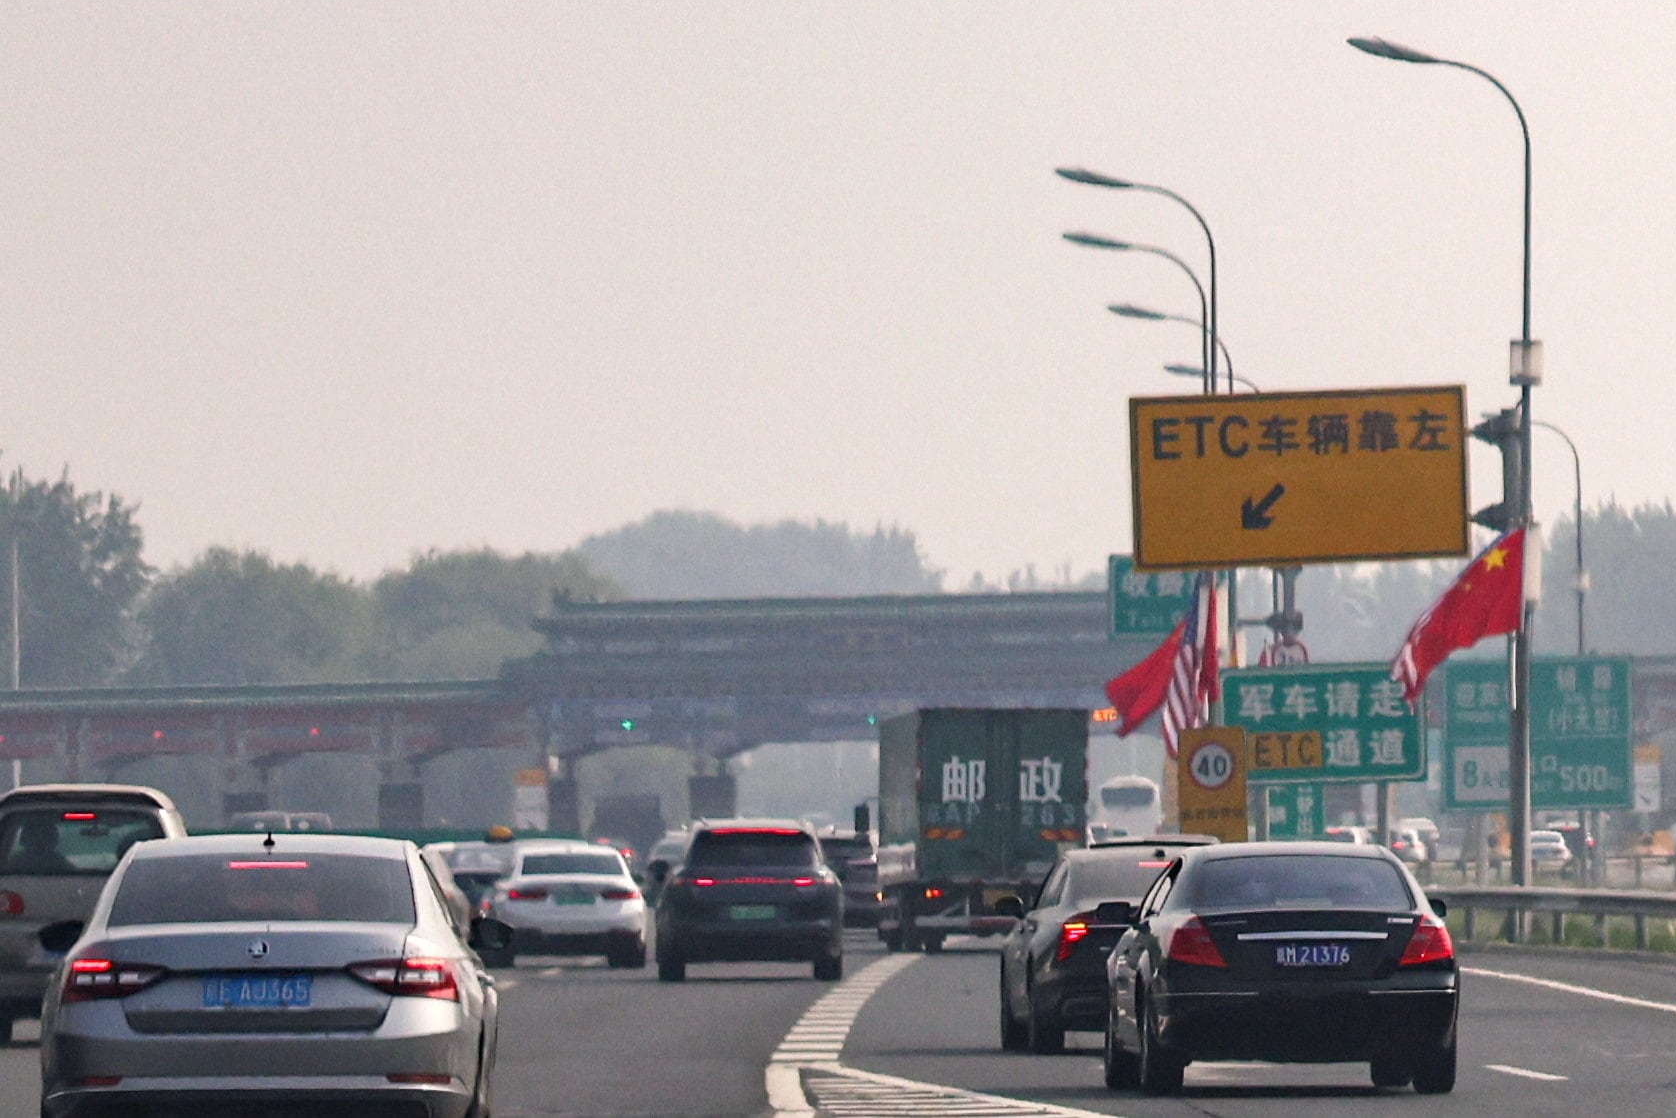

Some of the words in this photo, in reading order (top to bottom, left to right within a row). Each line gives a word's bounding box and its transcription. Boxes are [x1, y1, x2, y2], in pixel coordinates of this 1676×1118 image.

[1239, 680, 1405, 722] 军车请走
[942, 755, 1063, 803] 邮政
[1197, 755, 1227, 777] 40
